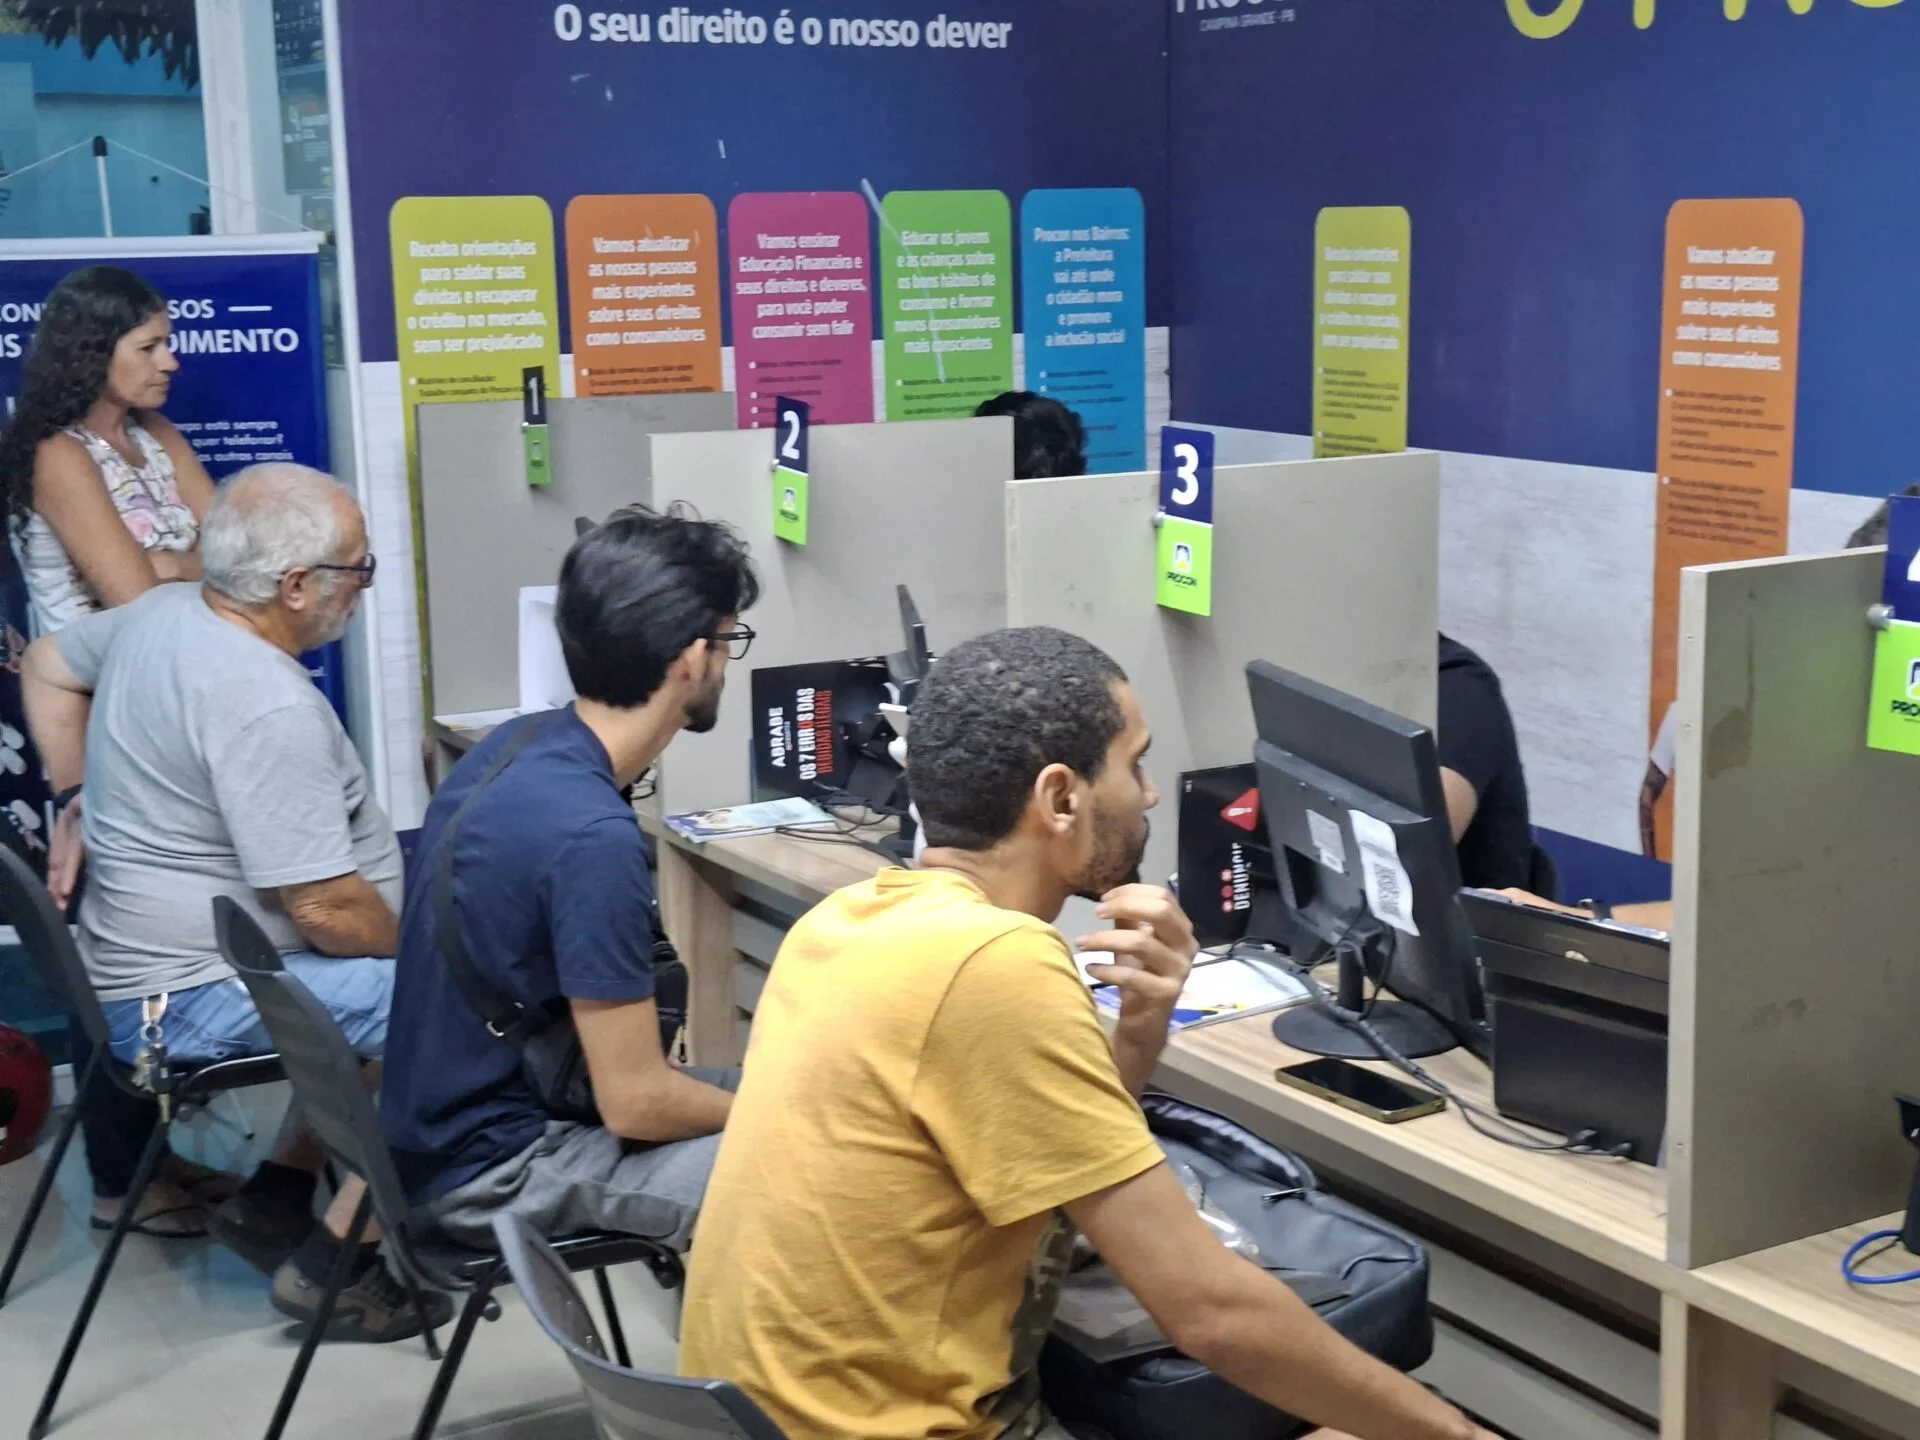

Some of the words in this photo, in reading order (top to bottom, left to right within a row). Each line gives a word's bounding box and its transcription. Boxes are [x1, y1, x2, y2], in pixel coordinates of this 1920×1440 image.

[554, 4, 582, 41] O
[589, 11, 650, 43] seu
[658, 8, 768, 44] direito
[773, 10, 795, 45] é
[802, 17, 823, 46] o
[829, 17, 920, 48] nosso
[926, 15, 1013, 49] dever
[757, 233, 797, 249] Vamos
[798, 232, 841, 248] ensinar
[901, 230, 939, 246] Educar
[940, 233, 954, 245] os
[955, 229, 990, 246] jovens
[1034, 227, 1071, 242] Procon
[1071, 229, 1090, 241] nos
[1091, 226, 1131, 241] Bairros:
[408, 241, 460, 257] Receba
[460, 240, 537, 259] orientações
[592, 238, 636, 254] Vamos
[637, 236, 690, 253] atualizar
[896, 255, 906, 268] e
[906, 255, 920, 268] as
[920, 252, 965, 269] crianças
[965, 251, 996, 266] sobre
[1055, 251, 1062, 262] a
[1063, 247, 1114, 262] Prefeitura
[1687, 246, 1724, 264] Vamos
[1725, 246, 1776, 265] atualizar
[588, 264, 604, 277] as
[605, 263, 647, 276] nossas
[648, 262, 698, 277] pessoas
[739, 256, 794, 274] Educação
[795, 254, 853, 271] Financeira
[854, 256, 863, 269] e
[420, 268, 451, 284] para
[452, 265, 494, 281] saldar
[495, 267, 526, 280] suas
[897, 277, 912, 289] os
[912, 274, 940, 289] bons
[940, 272, 980, 288] hábitos
[981, 272, 996, 287] de
[1054, 268, 1070, 284] vai
[1071, 268, 1088, 283] até
[1089, 267, 1115, 282] onde
[1680, 275, 1693, 289] as
[1694, 275, 1733, 290] nossas
[1733, 276, 1779, 292] pessoas
[592, 284, 623, 300] mais
[624, 283, 696, 301] experientes
[735, 282, 763, 295] seus
[764, 278, 809, 294] direitos
[809, 280, 818, 292] e
[818, 277, 868, 293] deveres,
[413, 289, 463, 306] dívidas
[463, 292, 474, 304] e
[474, 290, 539, 305] recuperar
[899, 297, 949, 311] consumo
[949, 297, 958, 309] e
[958, 294, 995, 309] formar
[1046, 293, 1055, 305] o
[1055, 289, 1096, 305] cidadão
[1096, 291, 1123, 303] mora
[588, 308, 625, 323] sobre
[625, 309, 654, 322] seus
[655, 305, 702, 321] direitos
[757, 303, 785, 319] para
[785, 299, 813, 315] você
[813, 298, 848, 316] poder
[1681, 297, 1708, 315] mais
[1709, 299, 1776, 318] experientes
[407, 317, 417, 329] o
[418, 313, 466, 329] crédito
[467, 315, 486, 328] no
[486, 310, 548, 328] mercado,
[893, 319, 928, 333] novos
[928, 315, 1001, 332] consumidores
[1058, 314, 1066, 326] e
[1066, 312, 1112, 326] promove
[586, 333, 621, 346] como
[622, 328, 706, 345] consumidores
[752, 321, 805, 339] consumir
[805, 323, 831, 337] sem
[831, 320, 855, 335] falir
[1045, 335, 1053, 347] a
[1053, 330, 1096, 346] inclusão
[1096, 328, 1126, 344] social
[1676, 322, 1708, 340] sobre
[1709, 327, 1735, 341] seus
[1735, 324, 1779, 344] direitos
[413, 340, 443, 353] sem
[443, 339, 465, 352] ser
[466, 334, 544, 354] prejudicado
[904, 338, 930, 353] mais
[931, 336, 993, 352] conscientes
[1672, 351, 1703, 365] como
[1704, 350, 1781, 371] consumidores
[528, 377, 539, 415] 1
[232, 419, 278, 433] sempre
[781, 410, 800, 460] 2
[222, 433, 284, 448] telefonar?
[214, 449, 253, 463] outros
[254, 448, 293, 462] canais
[1171, 443, 1199, 505] 3
[796, 688, 815, 712] DAS
[1891, 699, 1920, 717] PRO
[797, 713, 816, 752] ERROS
[799, 754, 816, 762] 7
[799, 763, 817, 780] OS
